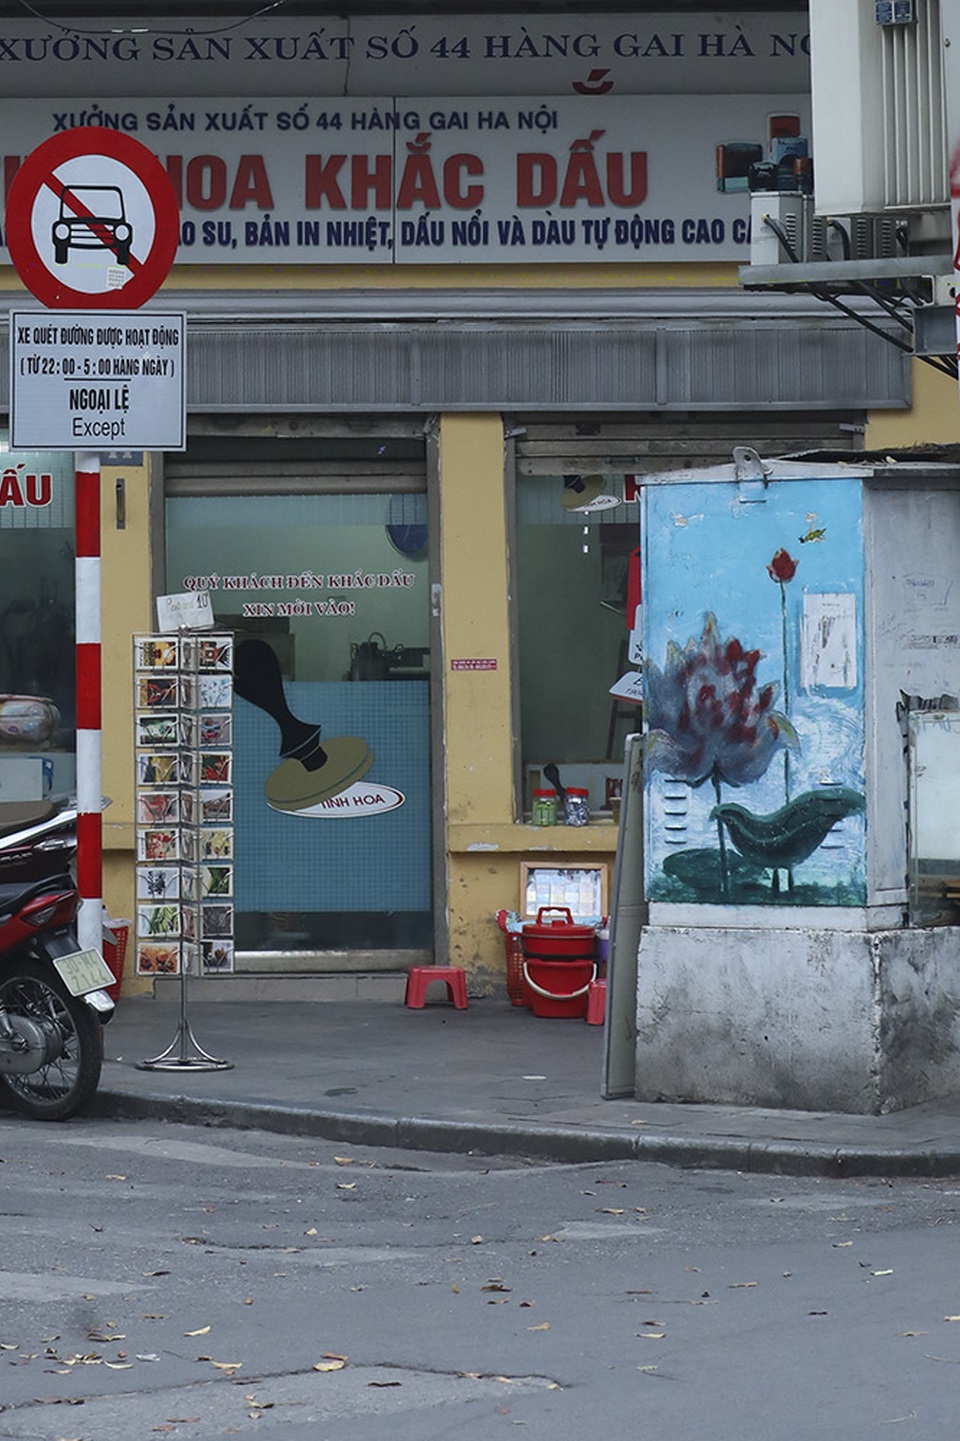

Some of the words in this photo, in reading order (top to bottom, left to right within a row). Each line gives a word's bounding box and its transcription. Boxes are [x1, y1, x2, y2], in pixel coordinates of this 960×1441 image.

[244, 28, 355, 60] XUẤT
[366, 25, 419, 59] SỐ
[430, 35, 471, 58] 44
[484, 26, 601, 58] HÀNG
[613, 33, 685, 58] GAI
[698, 25, 755, 58] HÀ
[53, 104, 138, 131] XƯỞNG
[146, 103, 195, 131] SẢN
[205, 103, 268, 131] XUẤT
[277, 102, 310, 131] SỐ
[316, 113, 343, 130] 44
[351, 103, 420, 130] HÀNG
[429, 111, 469, 130] GAI
[518, 105, 558, 134] NỘI
[305, 132, 484, 210] KHẮC
[516, 129, 649, 208] DẤU
[202, 221, 238, 249] SU,
[245, 214, 289, 247] BẢN
[297, 221, 321, 247] IN
[327, 215, 393, 251] NHIỆT,
[402, 211, 444, 246] DẤU
[451, 208, 489, 246] NỔI
[497, 216, 525, 246] VÀ
[582, 217, 610, 251] TỰ
[614, 213, 675, 249] ĐỘNG
[681, 218, 725, 246] CAO
[17, 326, 31, 345] XE
[60, 323, 94, 345] ĐƯỜNG
[96, 326, 123, 349] ĐƯỢC
[125, 328, 151, 349] HOẠT
[152, 325, 179, 349] ĐỘNG
[112, 355, 140, 376] HÀNG
[69, 388, 110, 414] NGOẠI
[114, 385, 129, 413] LỆ
[72, 418, 126, 440] Except
[223, 571, 284, 590] KHÁCH
[377, 568, 415, 589] DẤU
[242, 602, 275, 618] XIN
[277, 598, 312, 617] MỜI
[314, 597, 356, 616] VÀO!
[352, 793, 386, 806] HOA
